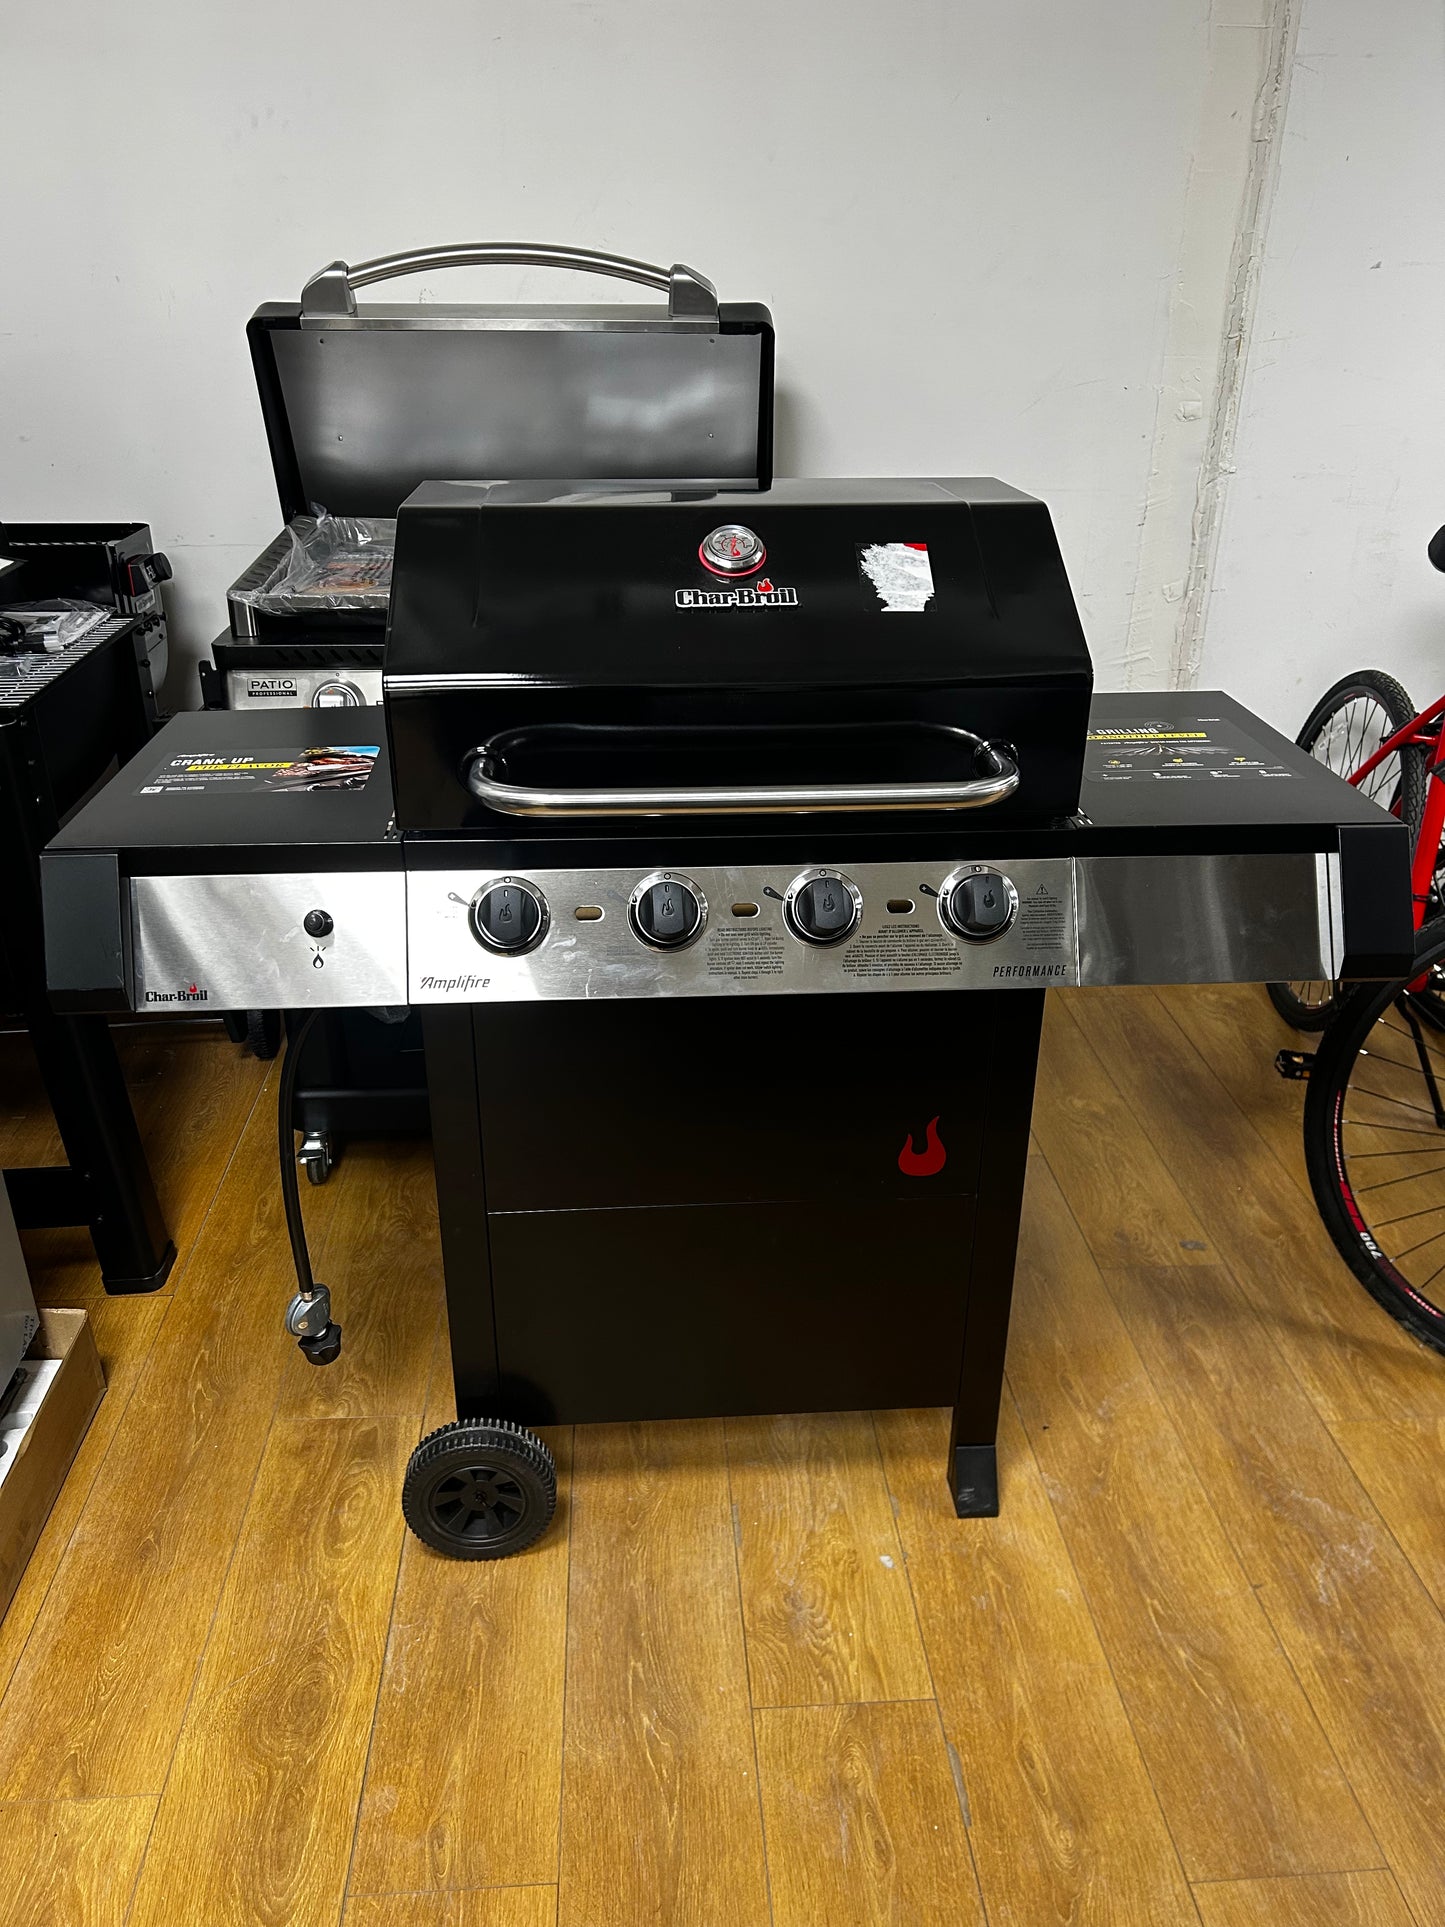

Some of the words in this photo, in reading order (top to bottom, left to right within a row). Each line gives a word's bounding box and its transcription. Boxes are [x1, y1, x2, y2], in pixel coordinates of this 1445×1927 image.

[675, 588, 798, 607] Char-Broil
[251, 680, 293, 689] PATIO
[170, 758, 227, 766] CRANK
[993, 965, 1067, 977] PERFORMANCE
[420, 975, 491, 992] Amplifire
[145, 990, 208, 1002] Char-Broil
